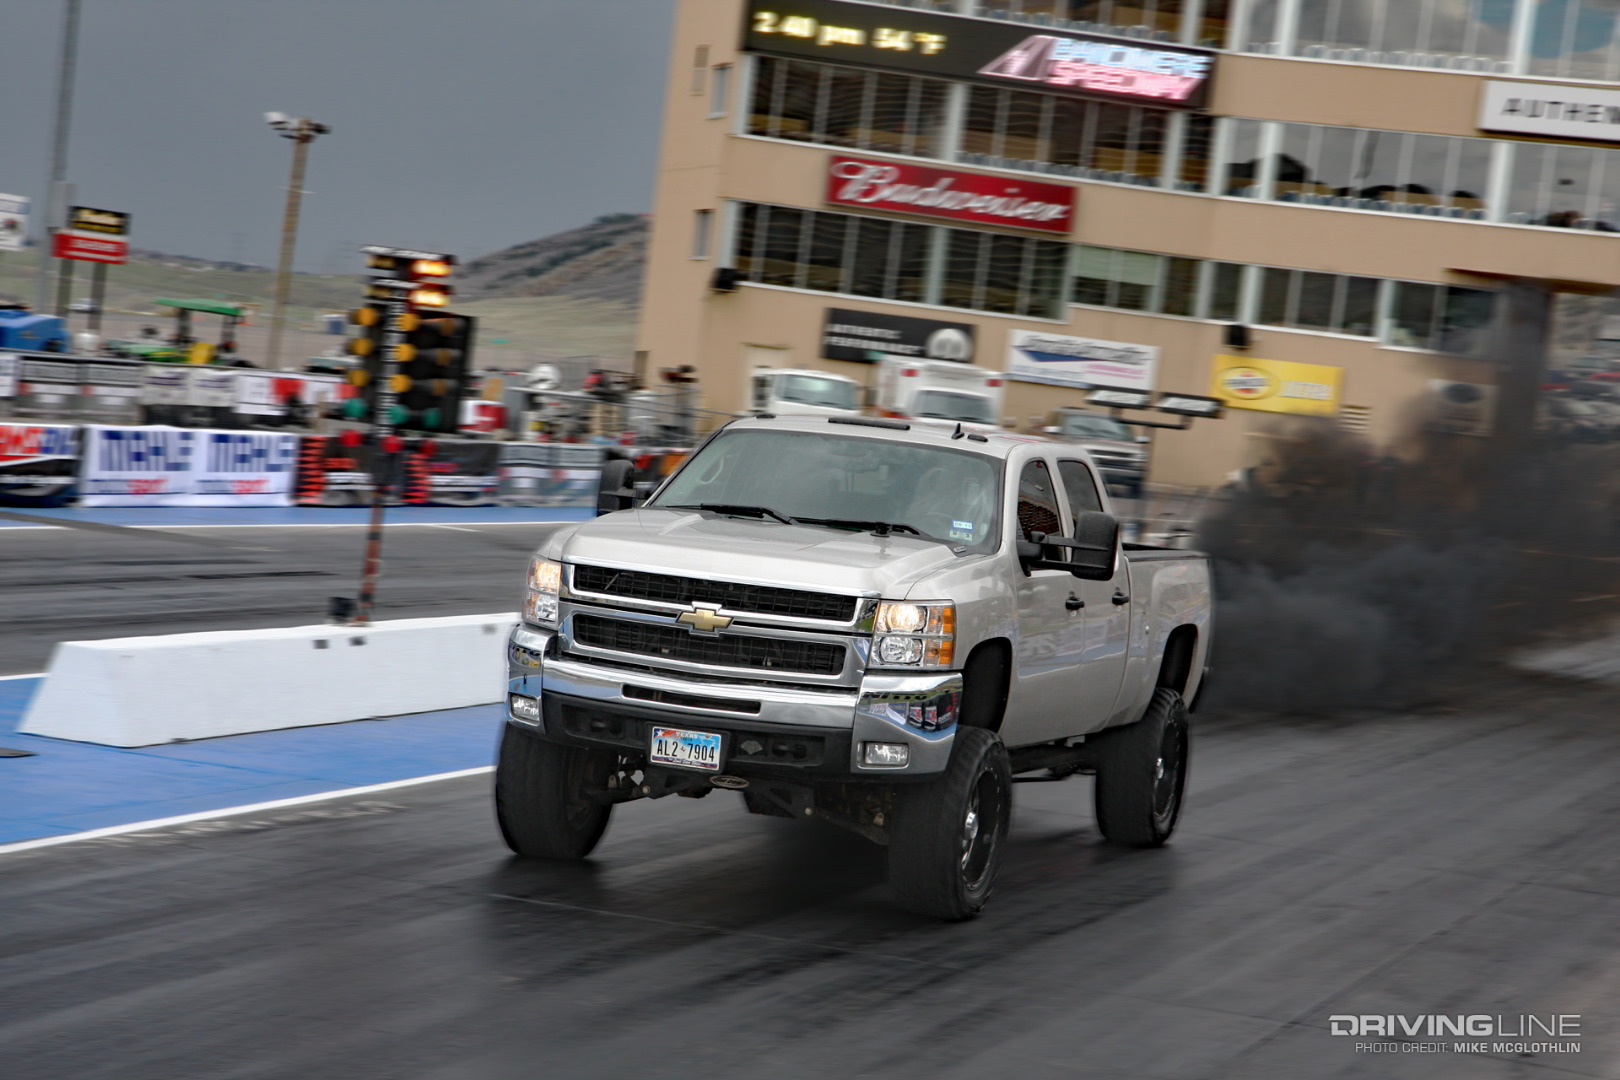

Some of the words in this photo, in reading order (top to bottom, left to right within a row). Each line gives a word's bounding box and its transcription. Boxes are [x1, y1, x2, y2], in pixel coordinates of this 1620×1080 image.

[816, 25, 867, 46] pm
[831, 162, 1071, 221] Budweiser
[102, 430, 191, 472] MAHLE
[207, 433, 295, 473] MAHLE
[676, 731, 698, 739] TEXAS
